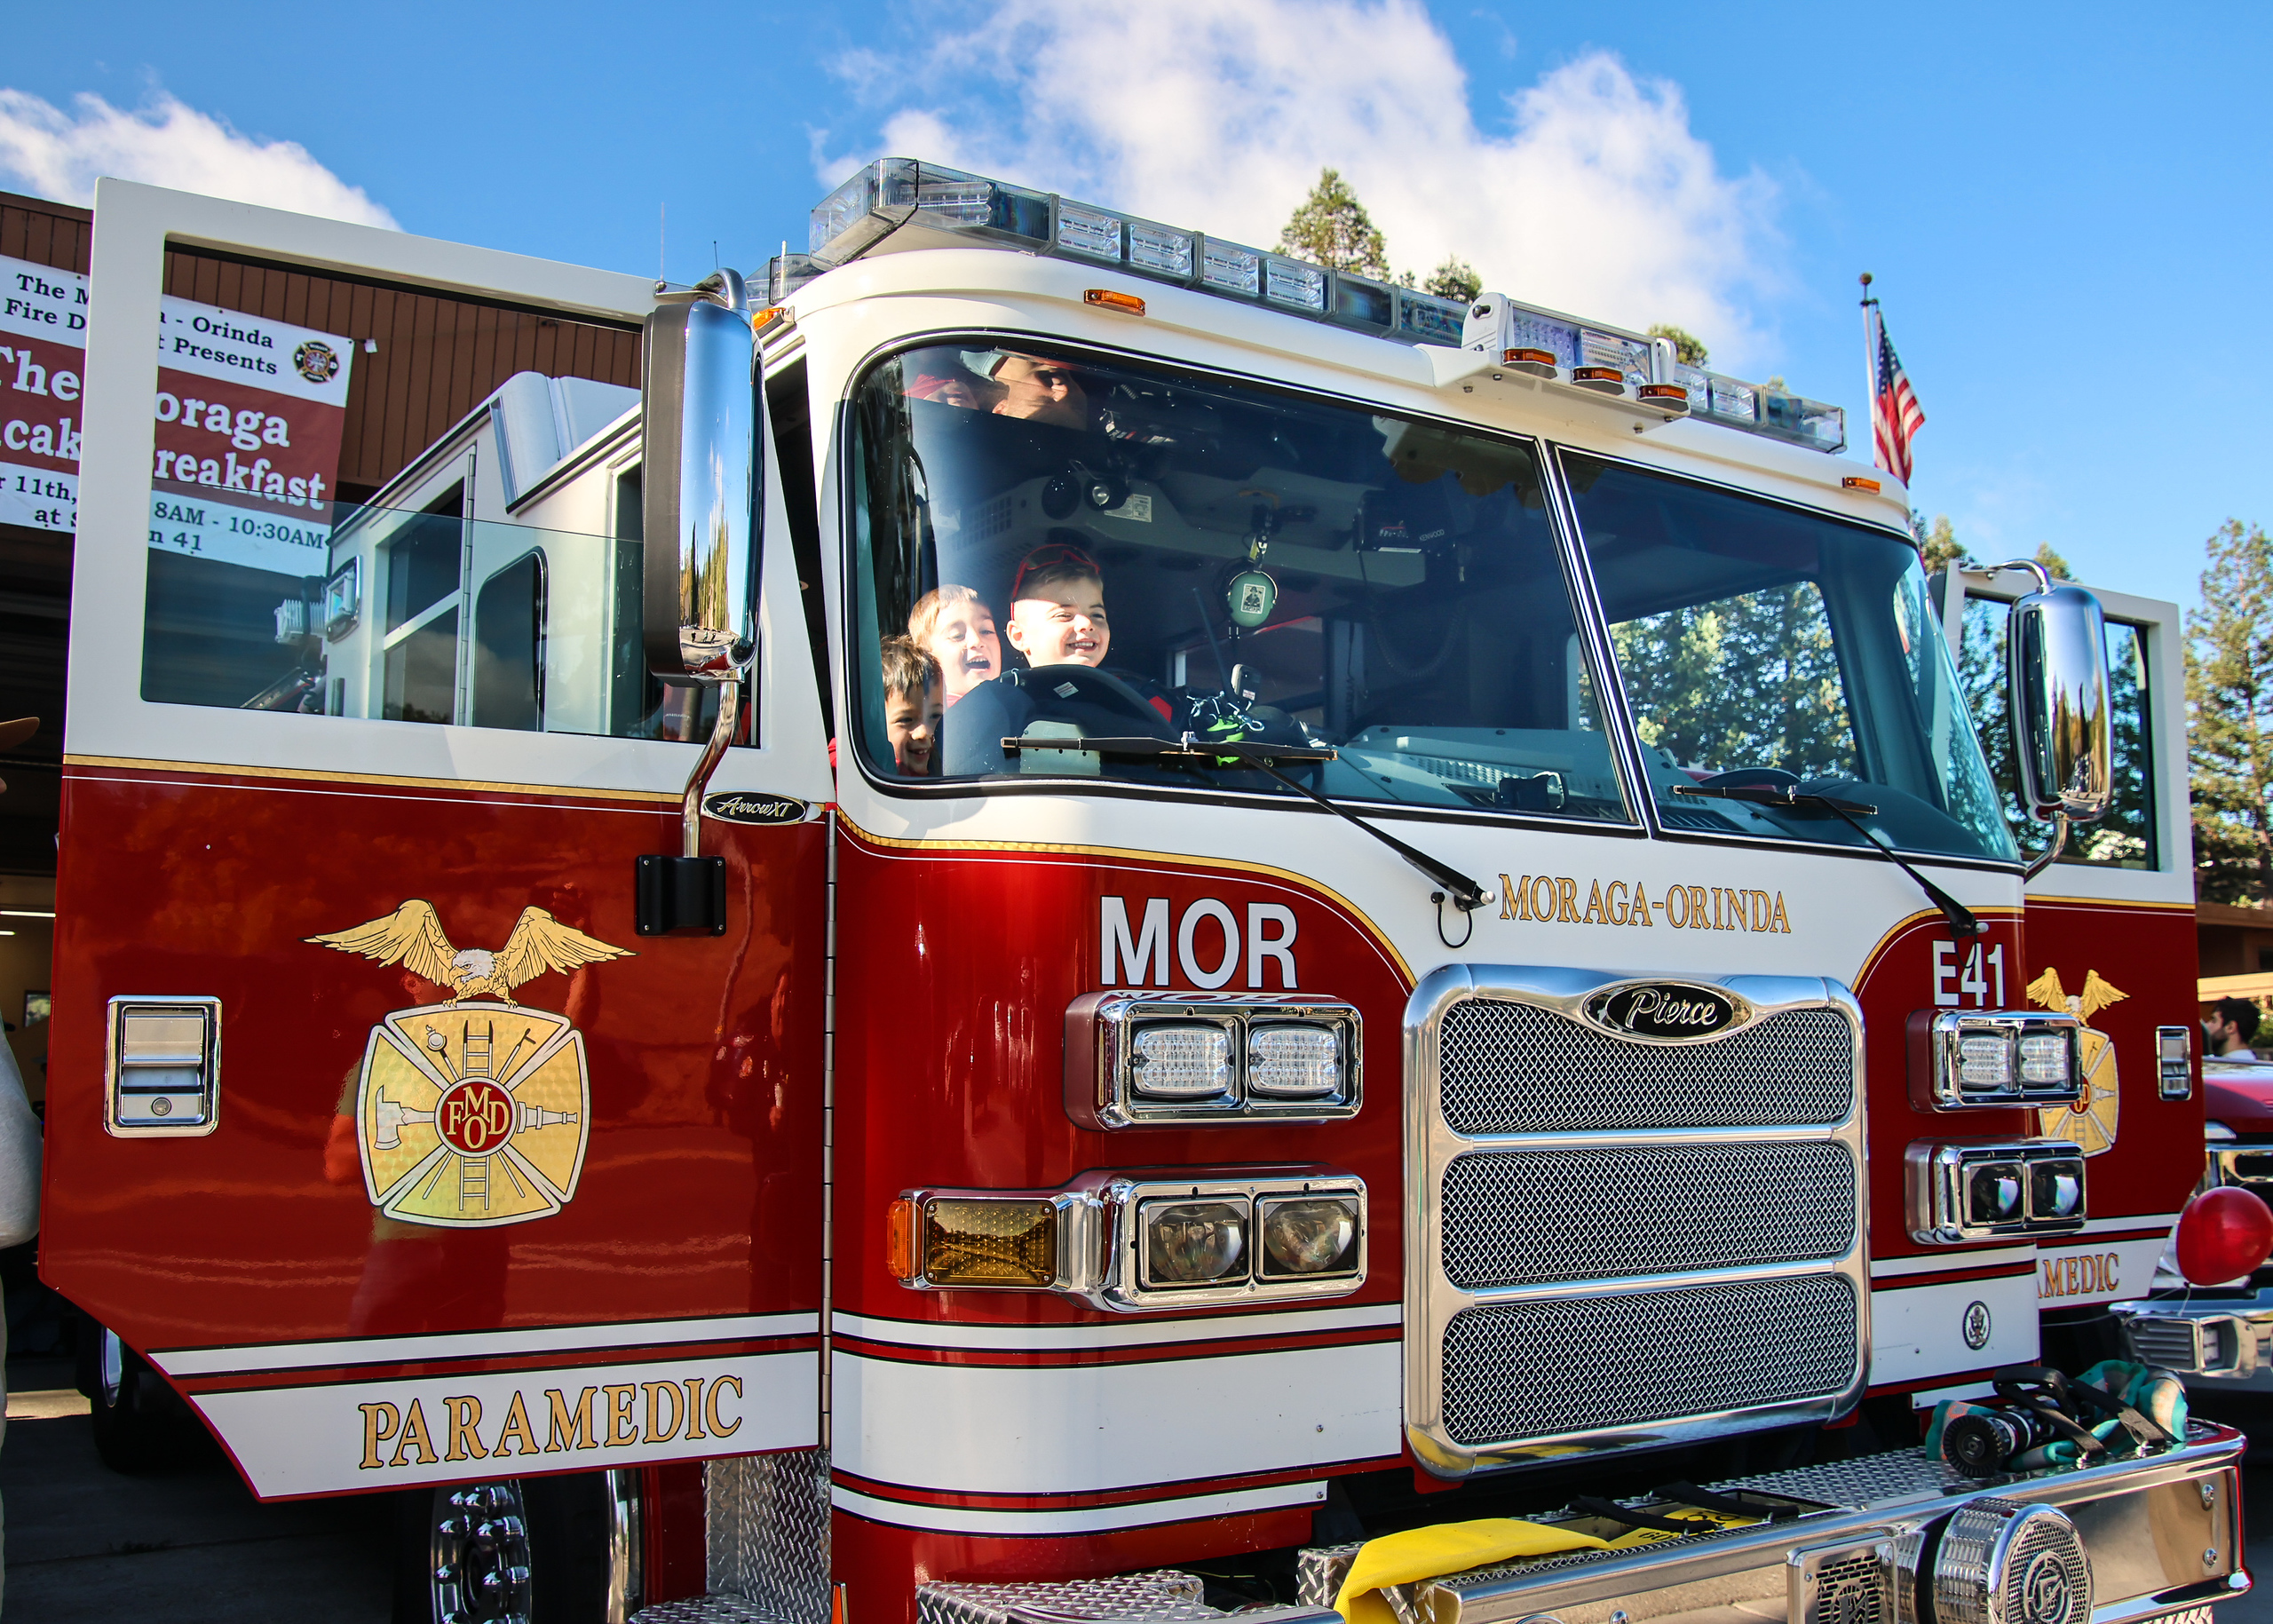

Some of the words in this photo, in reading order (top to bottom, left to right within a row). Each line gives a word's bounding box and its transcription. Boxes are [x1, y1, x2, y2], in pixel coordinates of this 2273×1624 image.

[4, 297, 58, 325] Fire
[172, 337, 277, 376] Presents
[16, 273, 66, 299] The
[192, 316, 273, 349] Orinda
[154, 391, 290, 452] oraga
[152, 446, 326, 511] reakfast
[15, 475, 78, 505] 11th,
[154, 502, 206, 527] 8AM
[229, 517, 324, 550] 10:30AM
[34, 508, 62, 526] at
[173, 530, 202, 551] 41
[1499, 873, 1792, 934] MORAGA-ORINDA
[1099, 894, 1300, 990] MOR
[1932, 939, 2005, 1008] E41
[1624, 987, 1718, 1030] Pierce
[2037, 1252, 2120, 1299] MEDIC
[358, 1374, 743, 1470] PARAMEDIC
